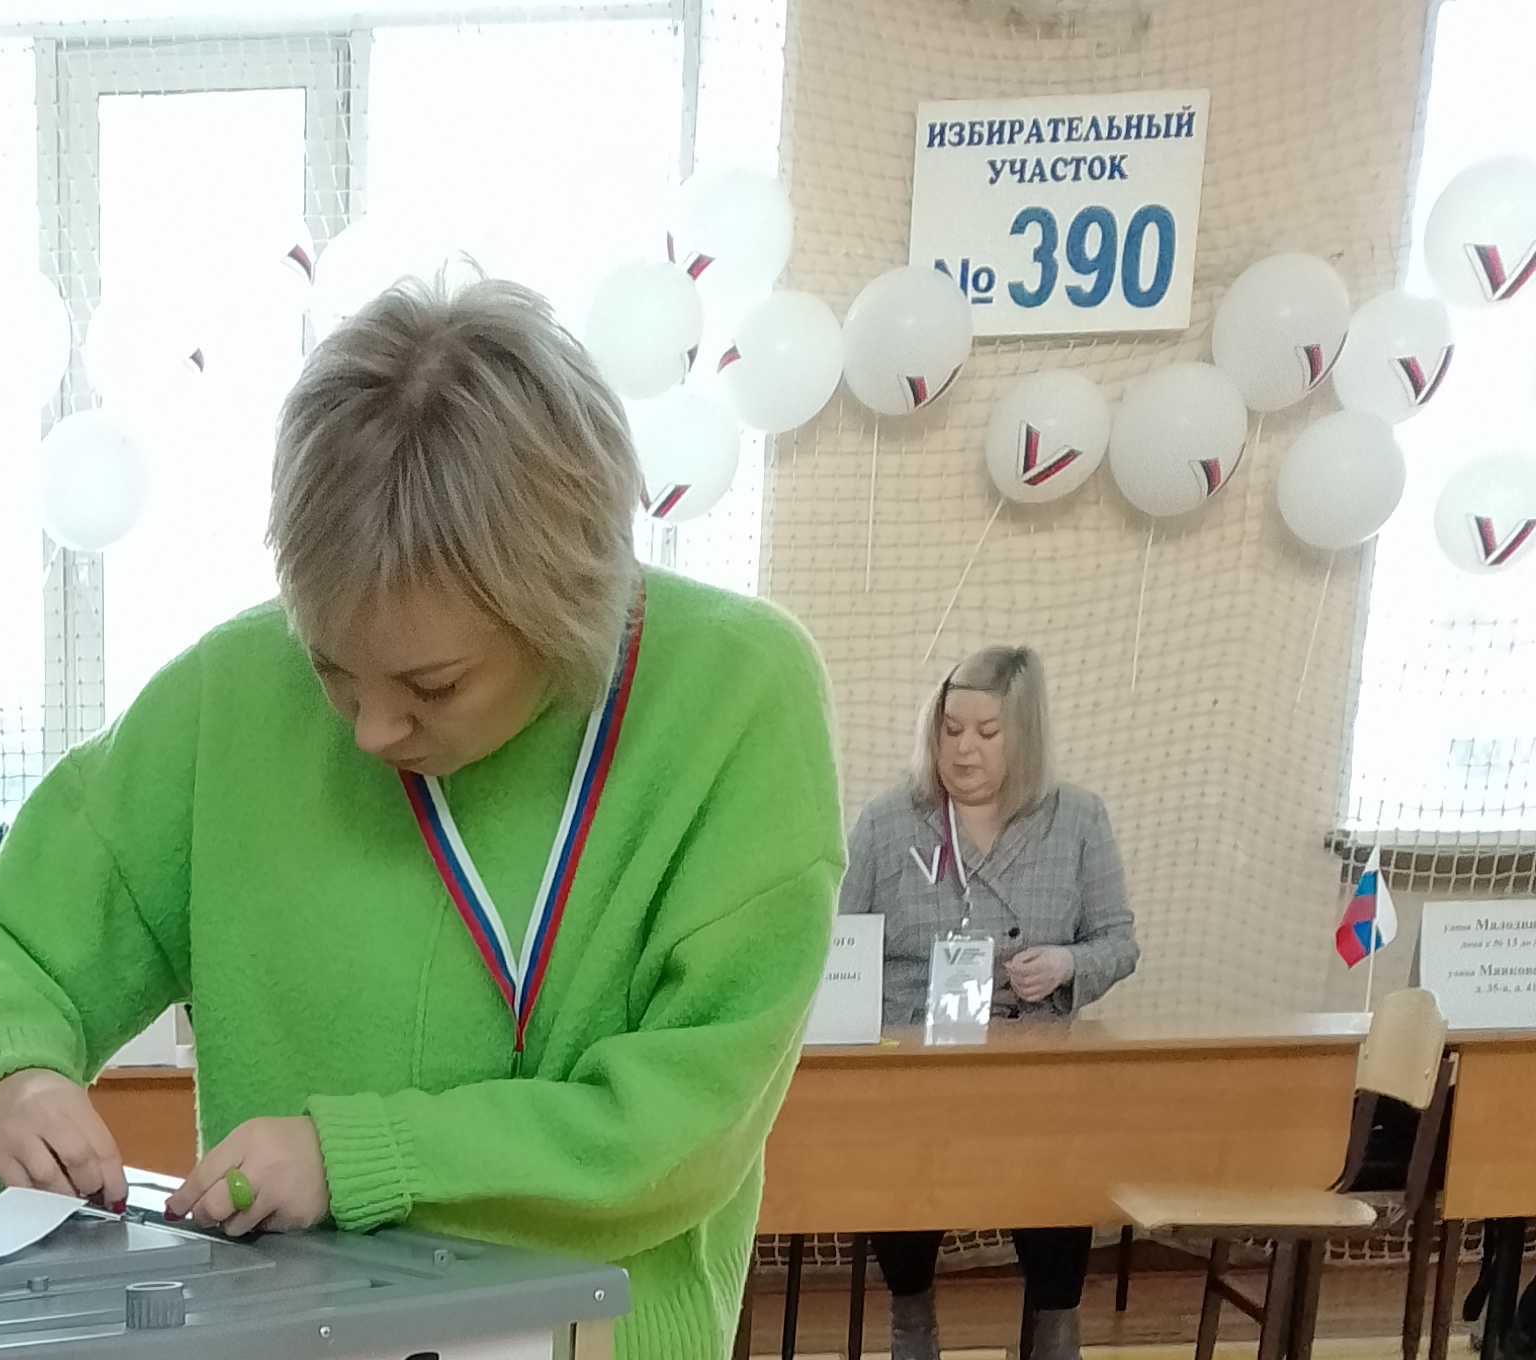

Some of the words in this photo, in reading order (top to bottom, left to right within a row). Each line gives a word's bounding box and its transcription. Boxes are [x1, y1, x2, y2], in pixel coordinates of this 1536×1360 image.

[926, 105, 1196, 149] ИЗБИРАТЕЛЬНЫЙ
[987, 154, 1129, 185] УЧАСТОК
[1007, 204, 1176, 309] 390
